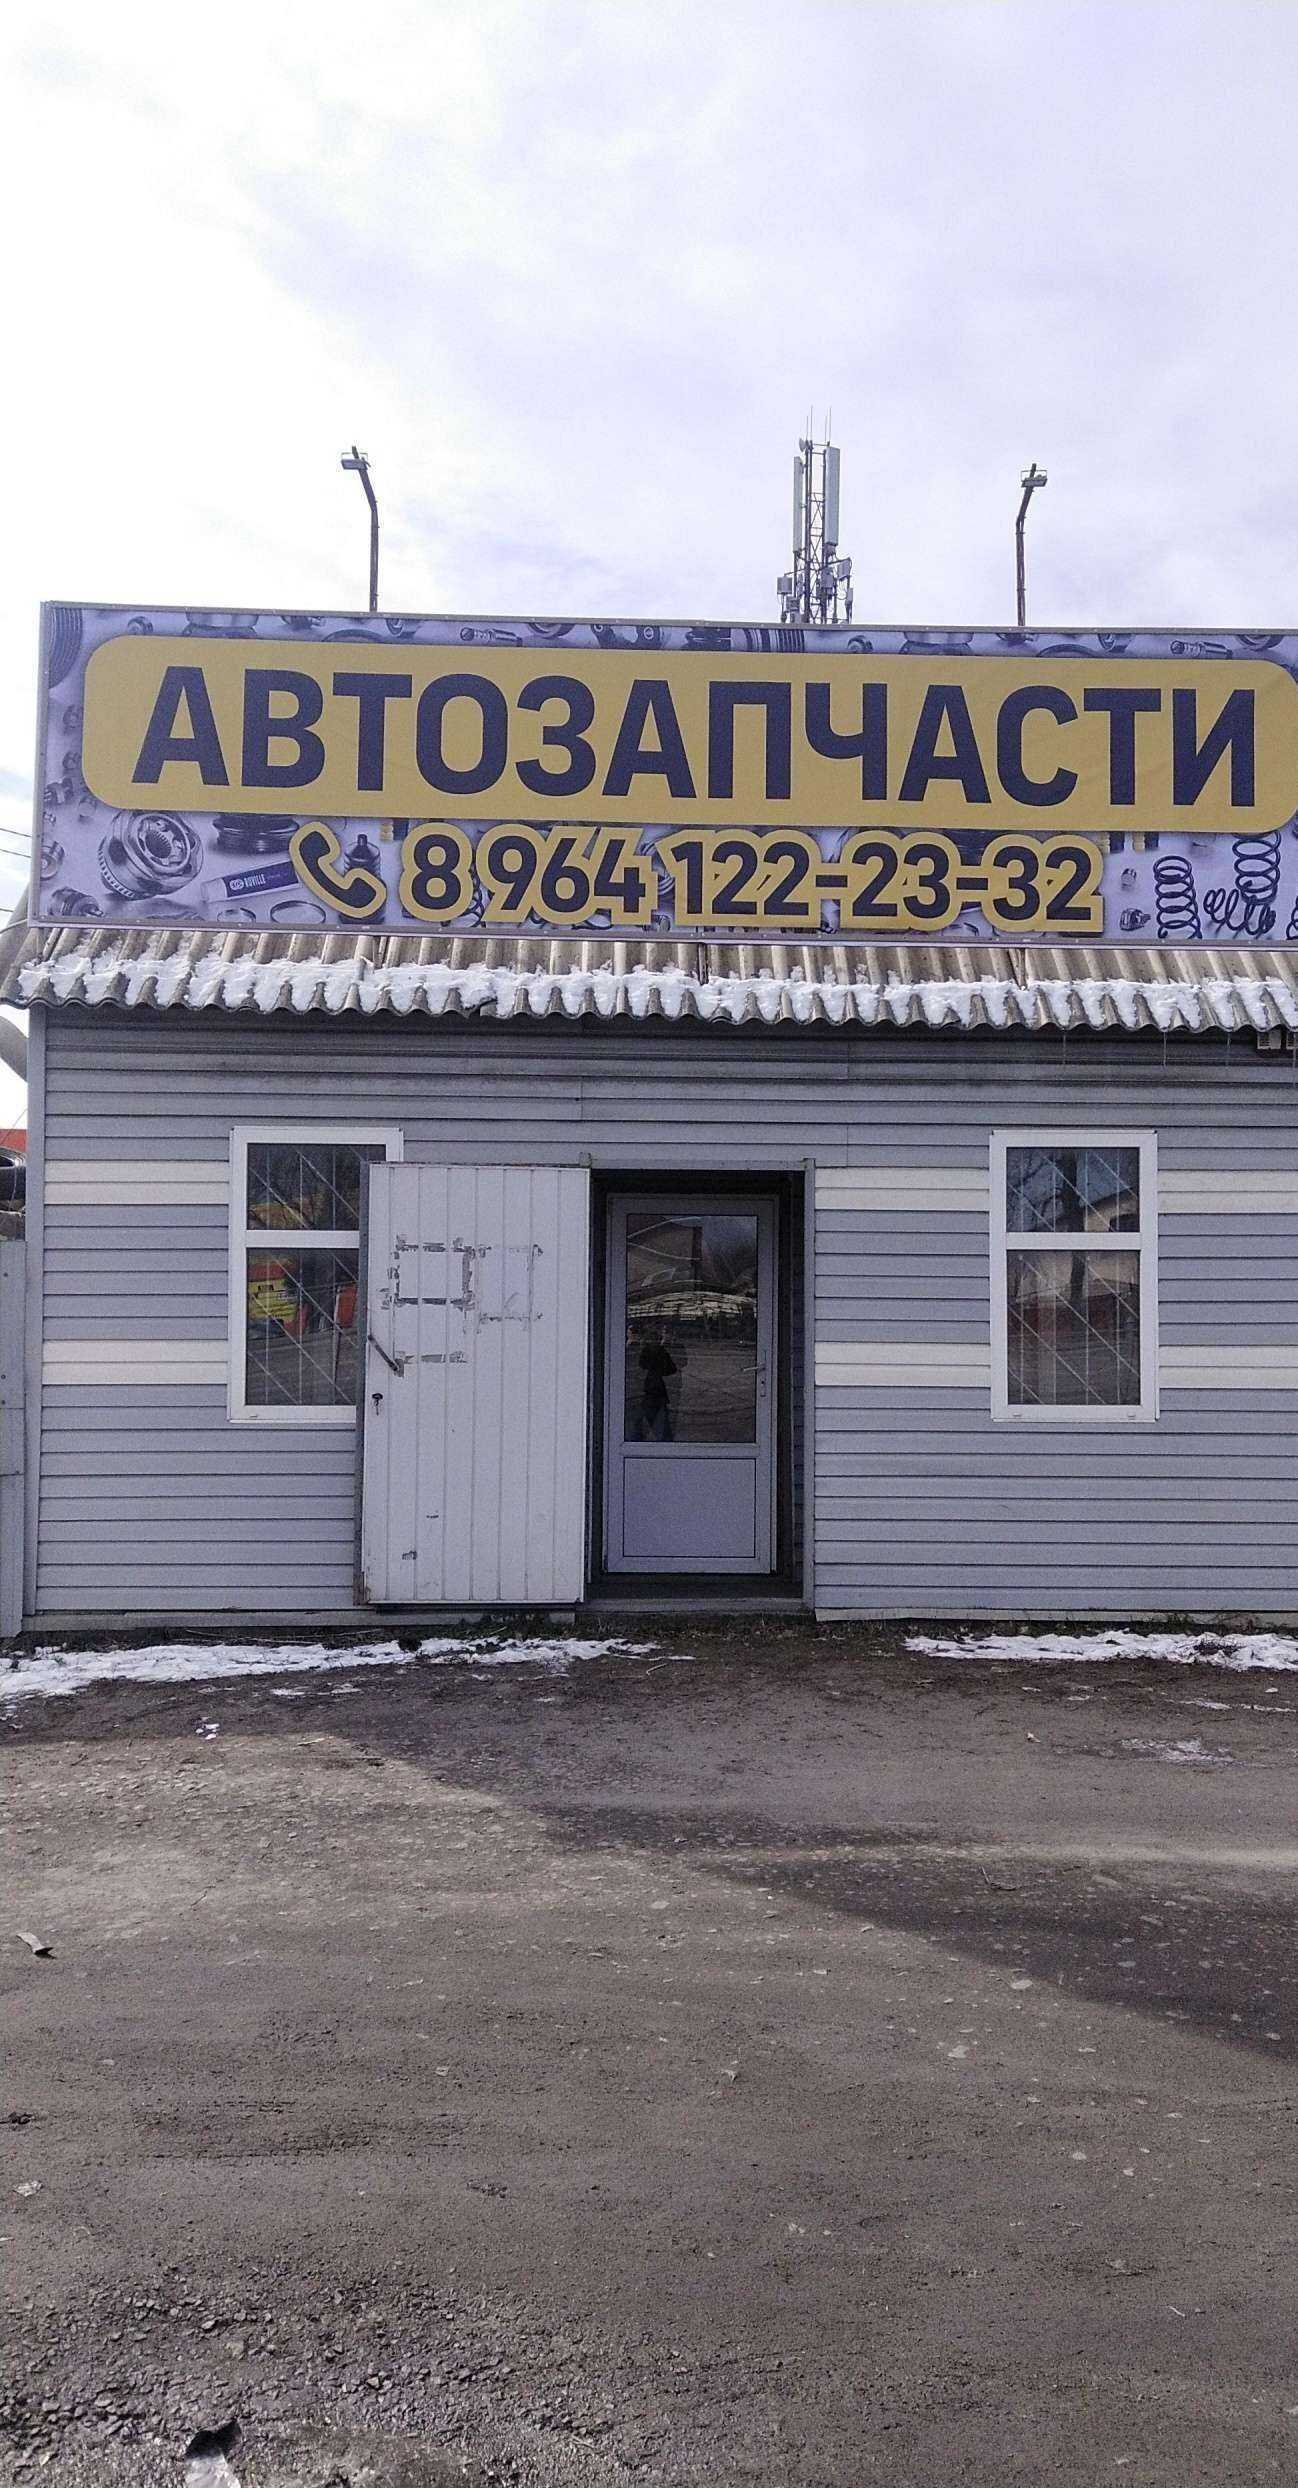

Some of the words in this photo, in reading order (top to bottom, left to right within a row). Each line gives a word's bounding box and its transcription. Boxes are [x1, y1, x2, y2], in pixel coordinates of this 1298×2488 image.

[132, 666, 1256, 807] АВТОЗАПЧАСТИ
[411, 834, 462, 910] 8
[487, 835, 646, 914] 964
[671, 841, 1092, 920] 122-23-32
